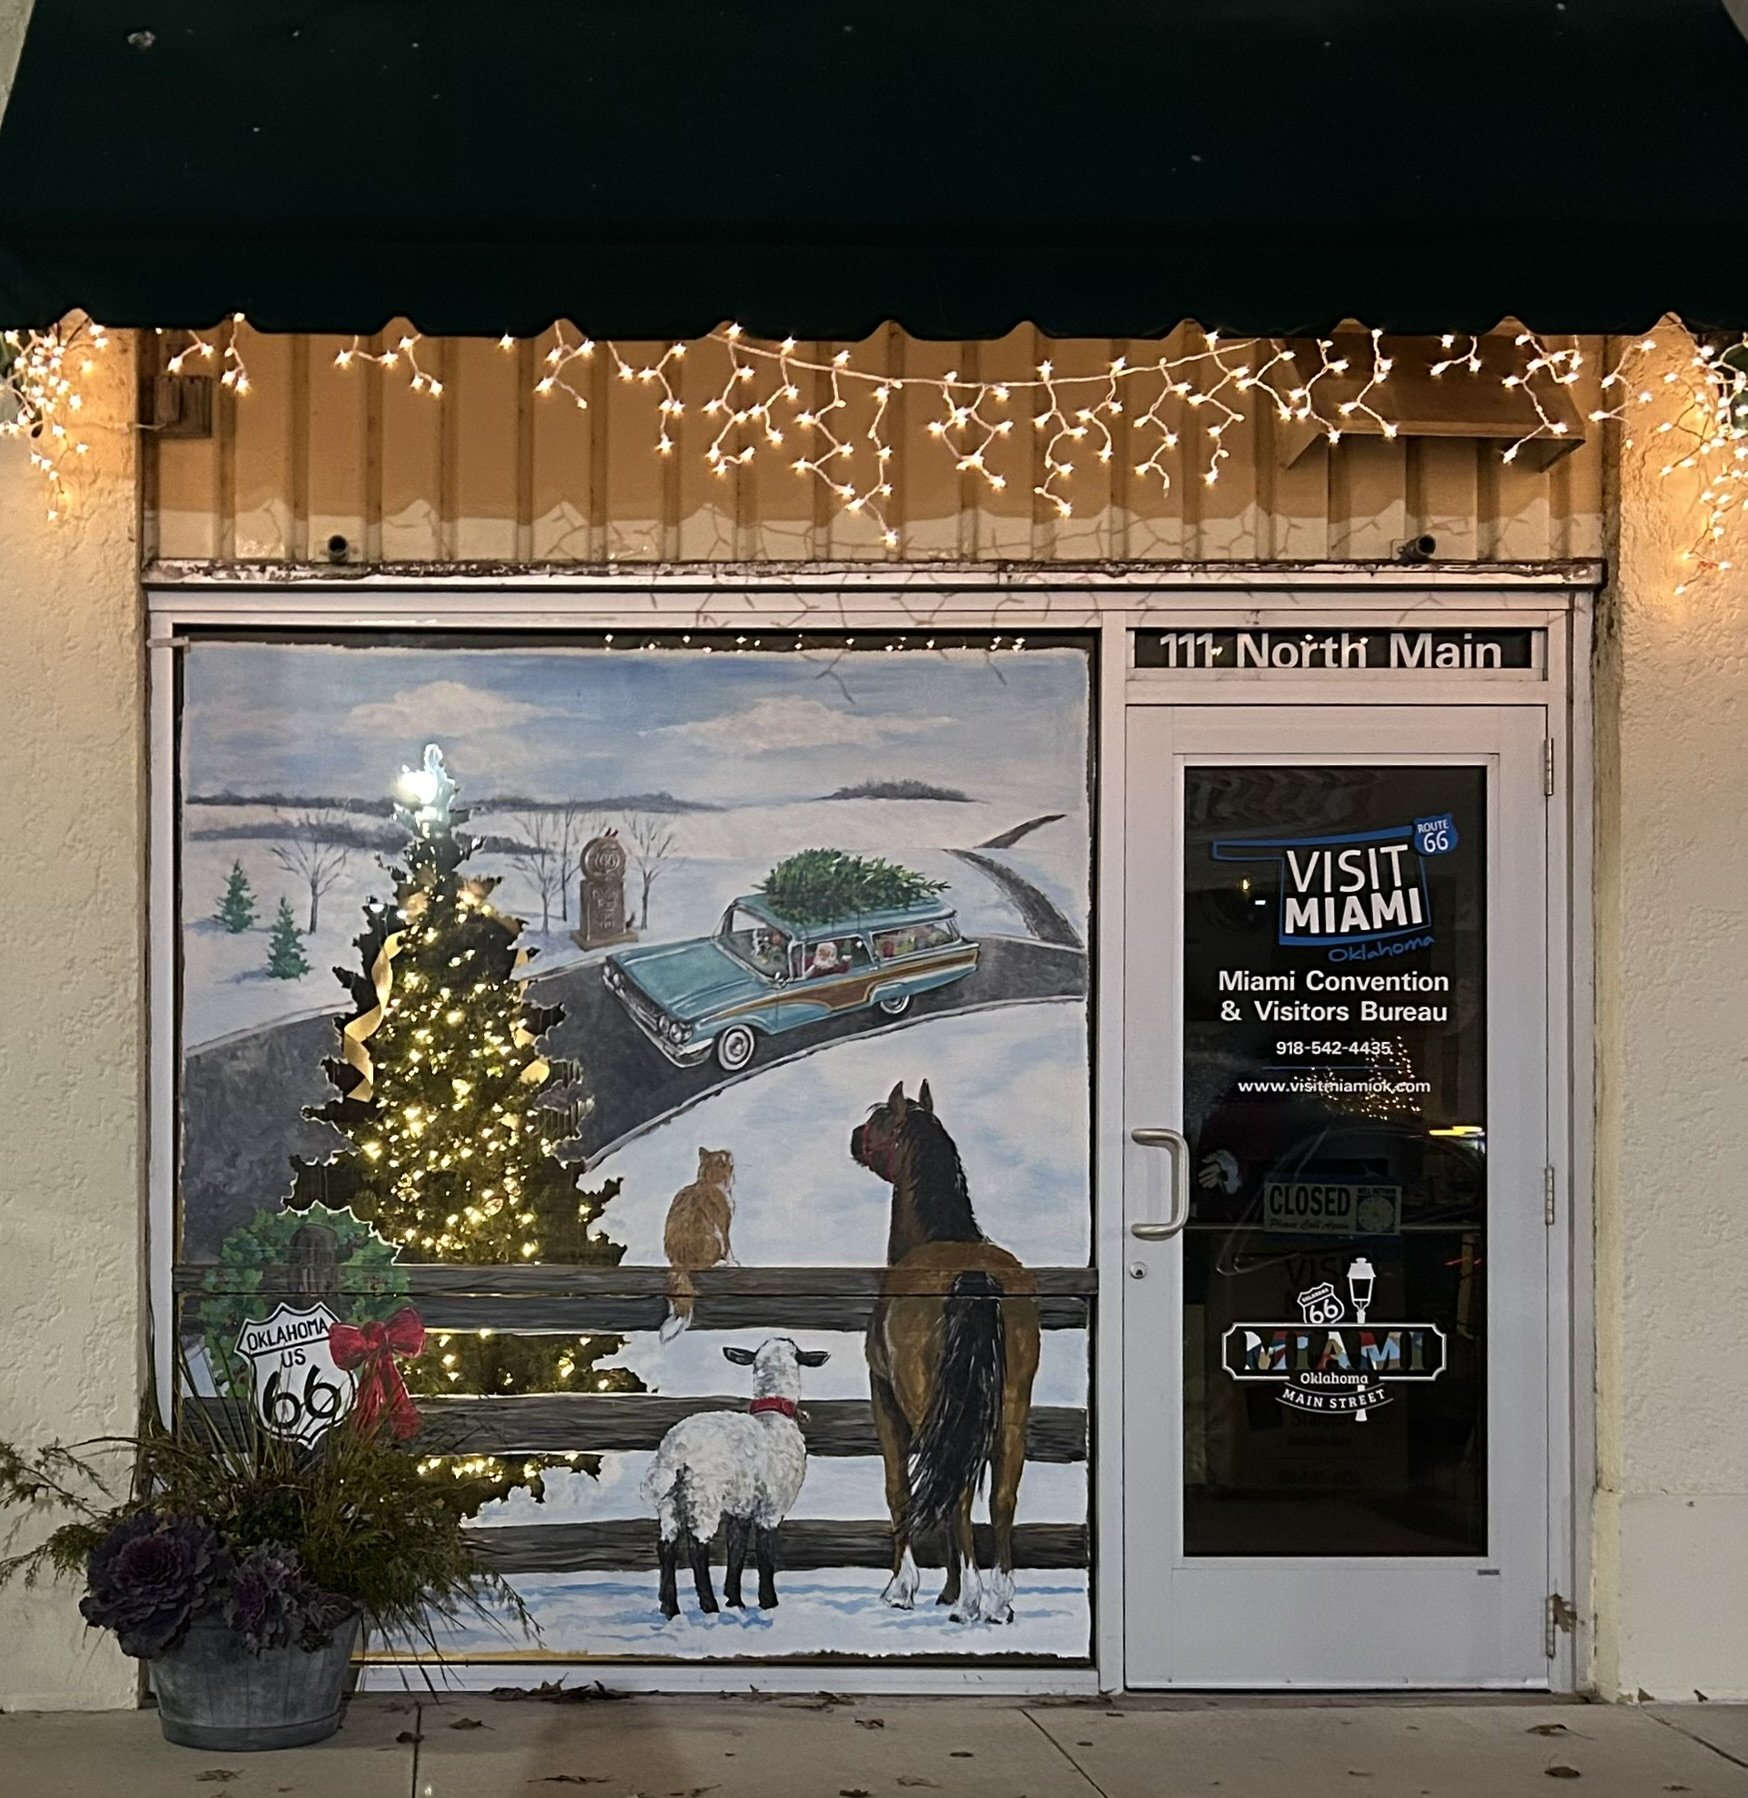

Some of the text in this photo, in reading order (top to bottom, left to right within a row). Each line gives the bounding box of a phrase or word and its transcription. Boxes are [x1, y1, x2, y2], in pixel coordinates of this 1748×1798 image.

[1159, 632, 1502, 668] 111 North Main
[1417, 819, 1449, 834] ROUTE
[1423, 830, 1449, 853] 66
[1286, 844, 1408, 893] VISIT
[1284, 887, 1423, 934] MIAMI
[1328, 935, 1435, 962] Oklahoma
[1218, 970, 1449, 992] Miami Convention
[1220, 1000, 1448, 1022] & Visitors Bureau
[1276, 1041, 1391, 1056] 918-542-4435
[1238, 1078, 1431, 1093] www.visitmiamiok.com
[1269, 1185, 1351, 1217] CLOSED
[1309, 1298, 1339, 1324] 66
[246, 1317, 331, 1351] OKLAHOMA
[281, 1348, 307, 1369] US
[1244, 1330, 1427, 1371] MIAMI
[1300, 1371, 1369, 1385] Oklahoma
[262, 1365, 342, 1430] 66
[1282, 1388, 1385, 1409] MAIN STREET
